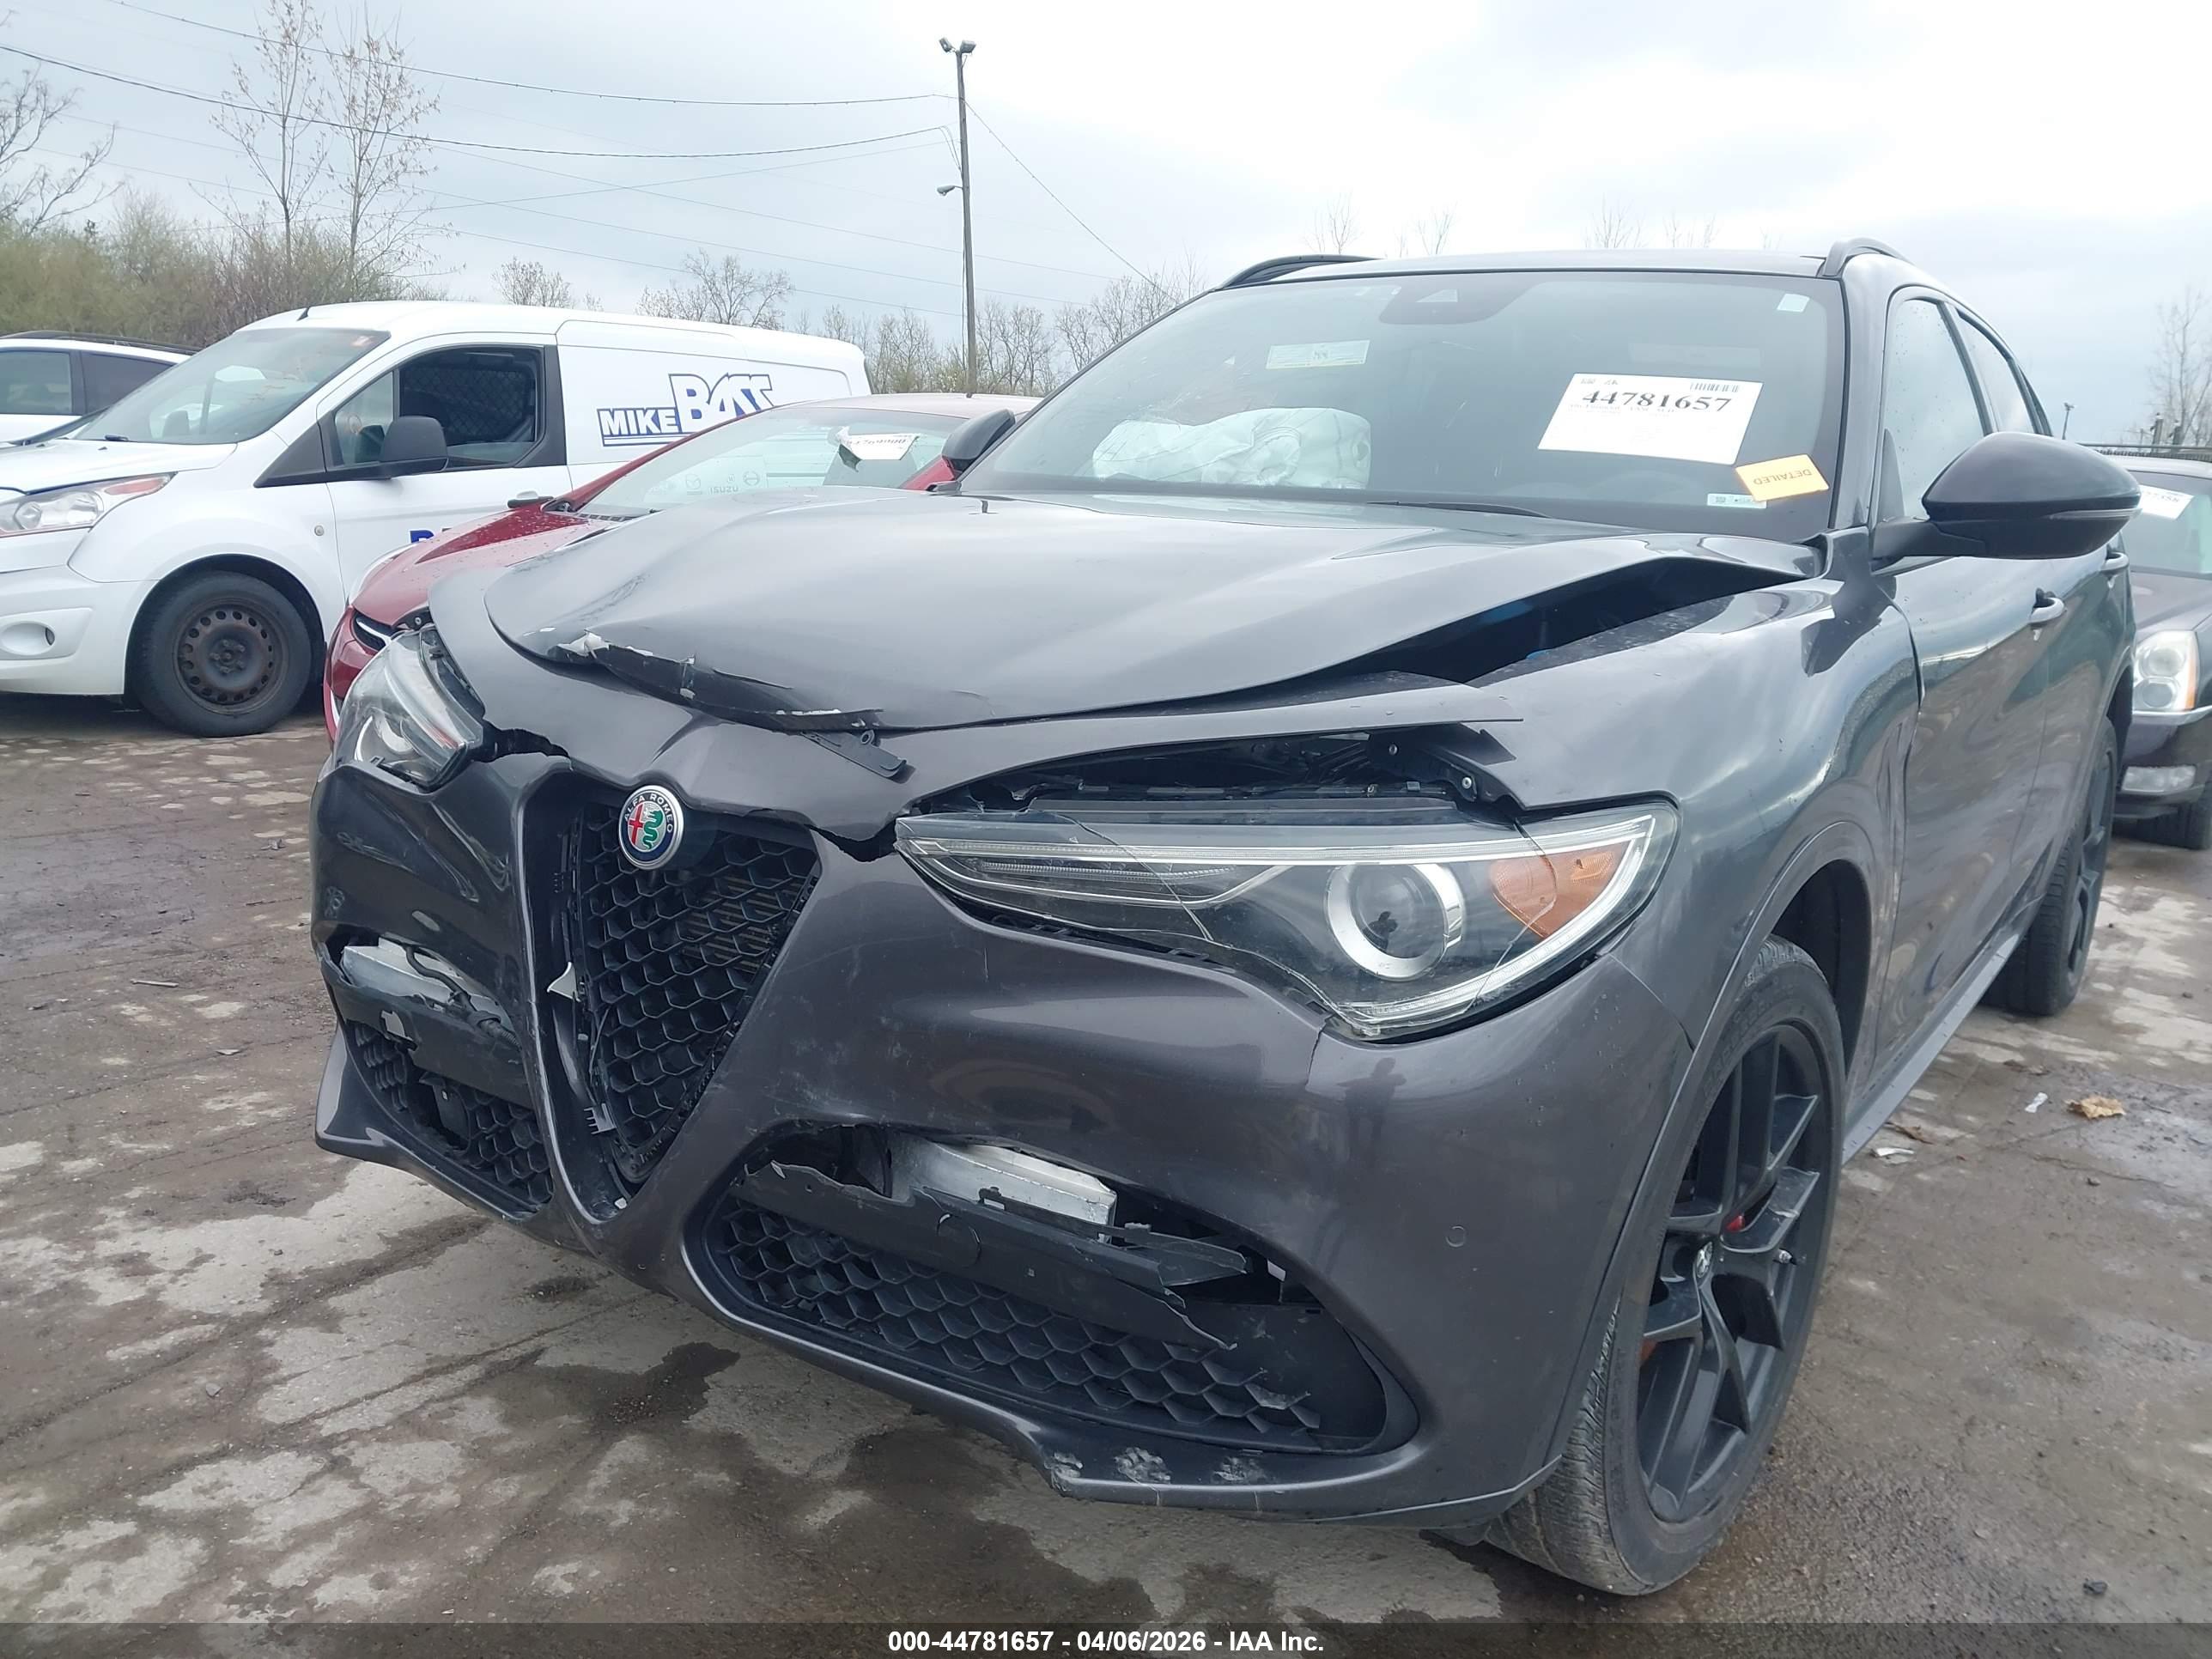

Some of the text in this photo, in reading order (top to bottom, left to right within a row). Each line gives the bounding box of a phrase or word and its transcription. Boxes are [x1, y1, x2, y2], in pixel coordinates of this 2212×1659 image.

[1582, 390, 1732, 412] 44781657
[597, 408, 678, 436] MIKE
[1753, 468, 1814, 486] DETAILED
[710, 485, 739, 495] ISUZU
[624, 793, 673, 834] ALFA ROMEO
